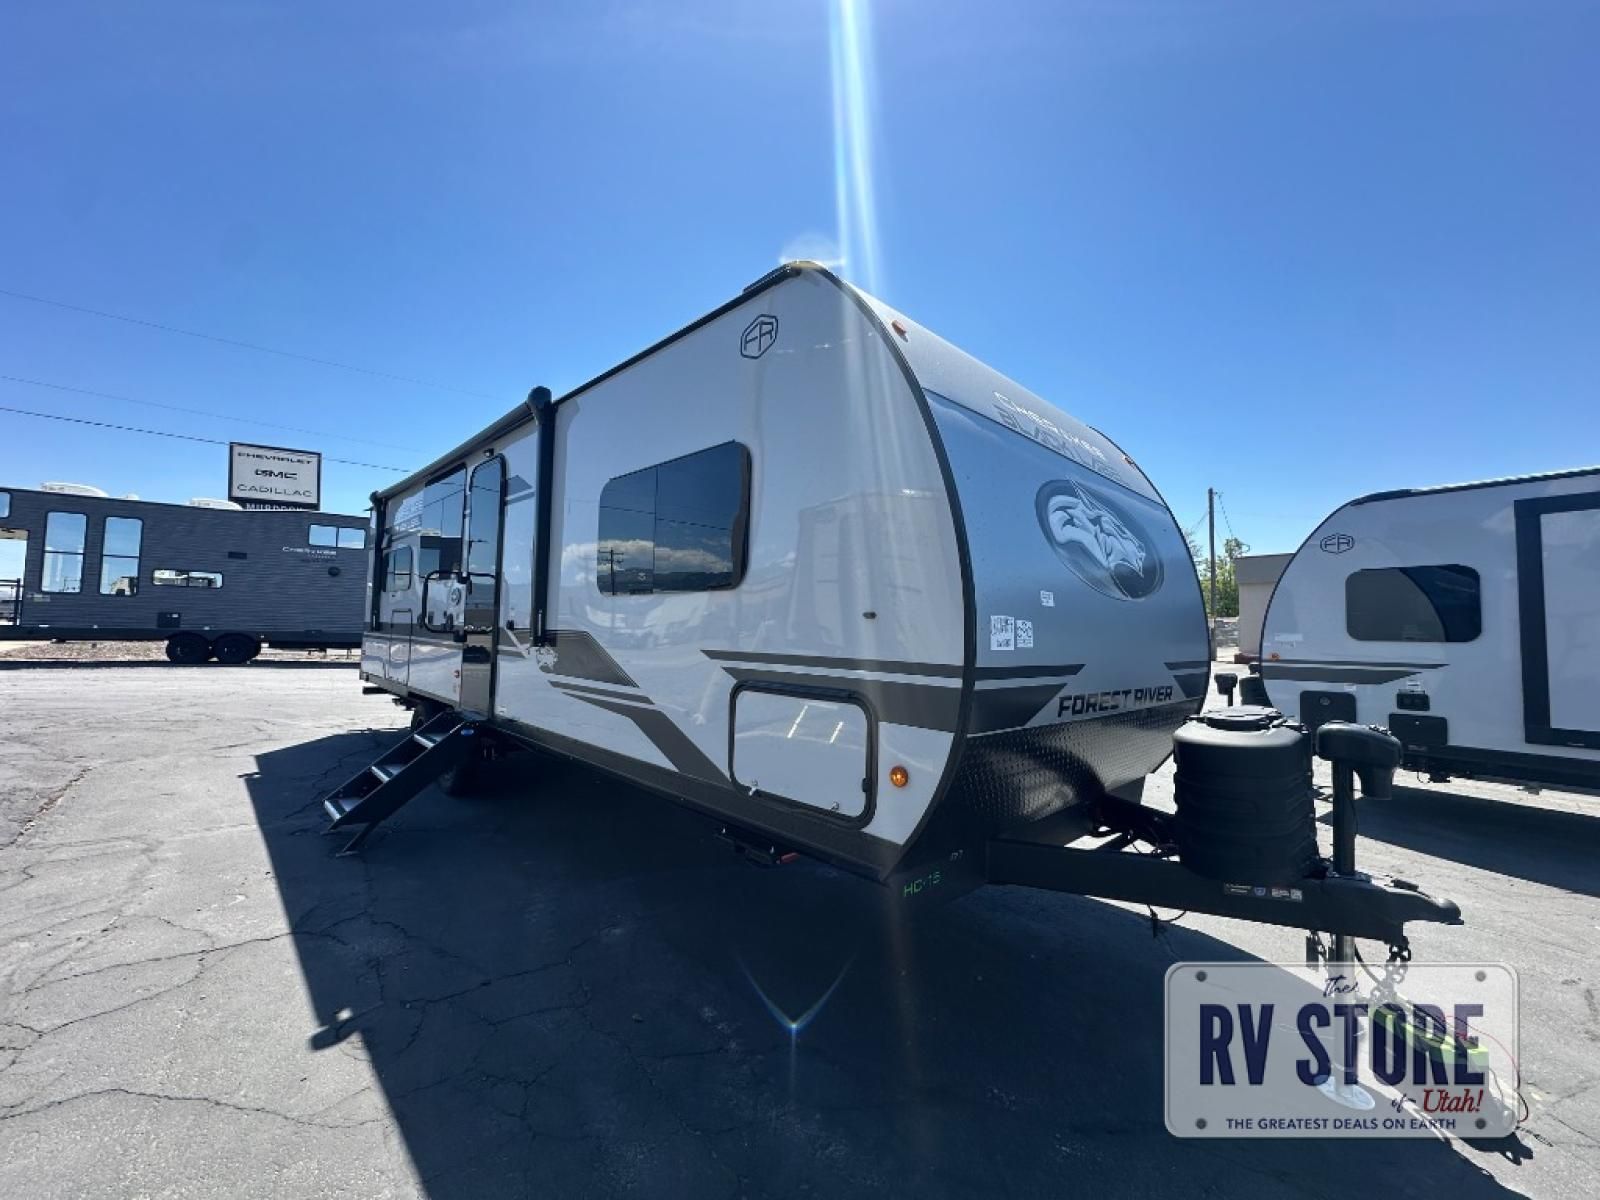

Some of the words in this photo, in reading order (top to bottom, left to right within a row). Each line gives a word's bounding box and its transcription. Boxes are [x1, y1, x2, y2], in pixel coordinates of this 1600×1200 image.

[237, 451, 313, 465] CHEVROLET
[255, 468, 298, 480] GMC
[237, 484, 312, 498] CADILLAC
[1057, 688, 1132, 718] FOREST
[1134, 685, 1173, 704] RIVER
